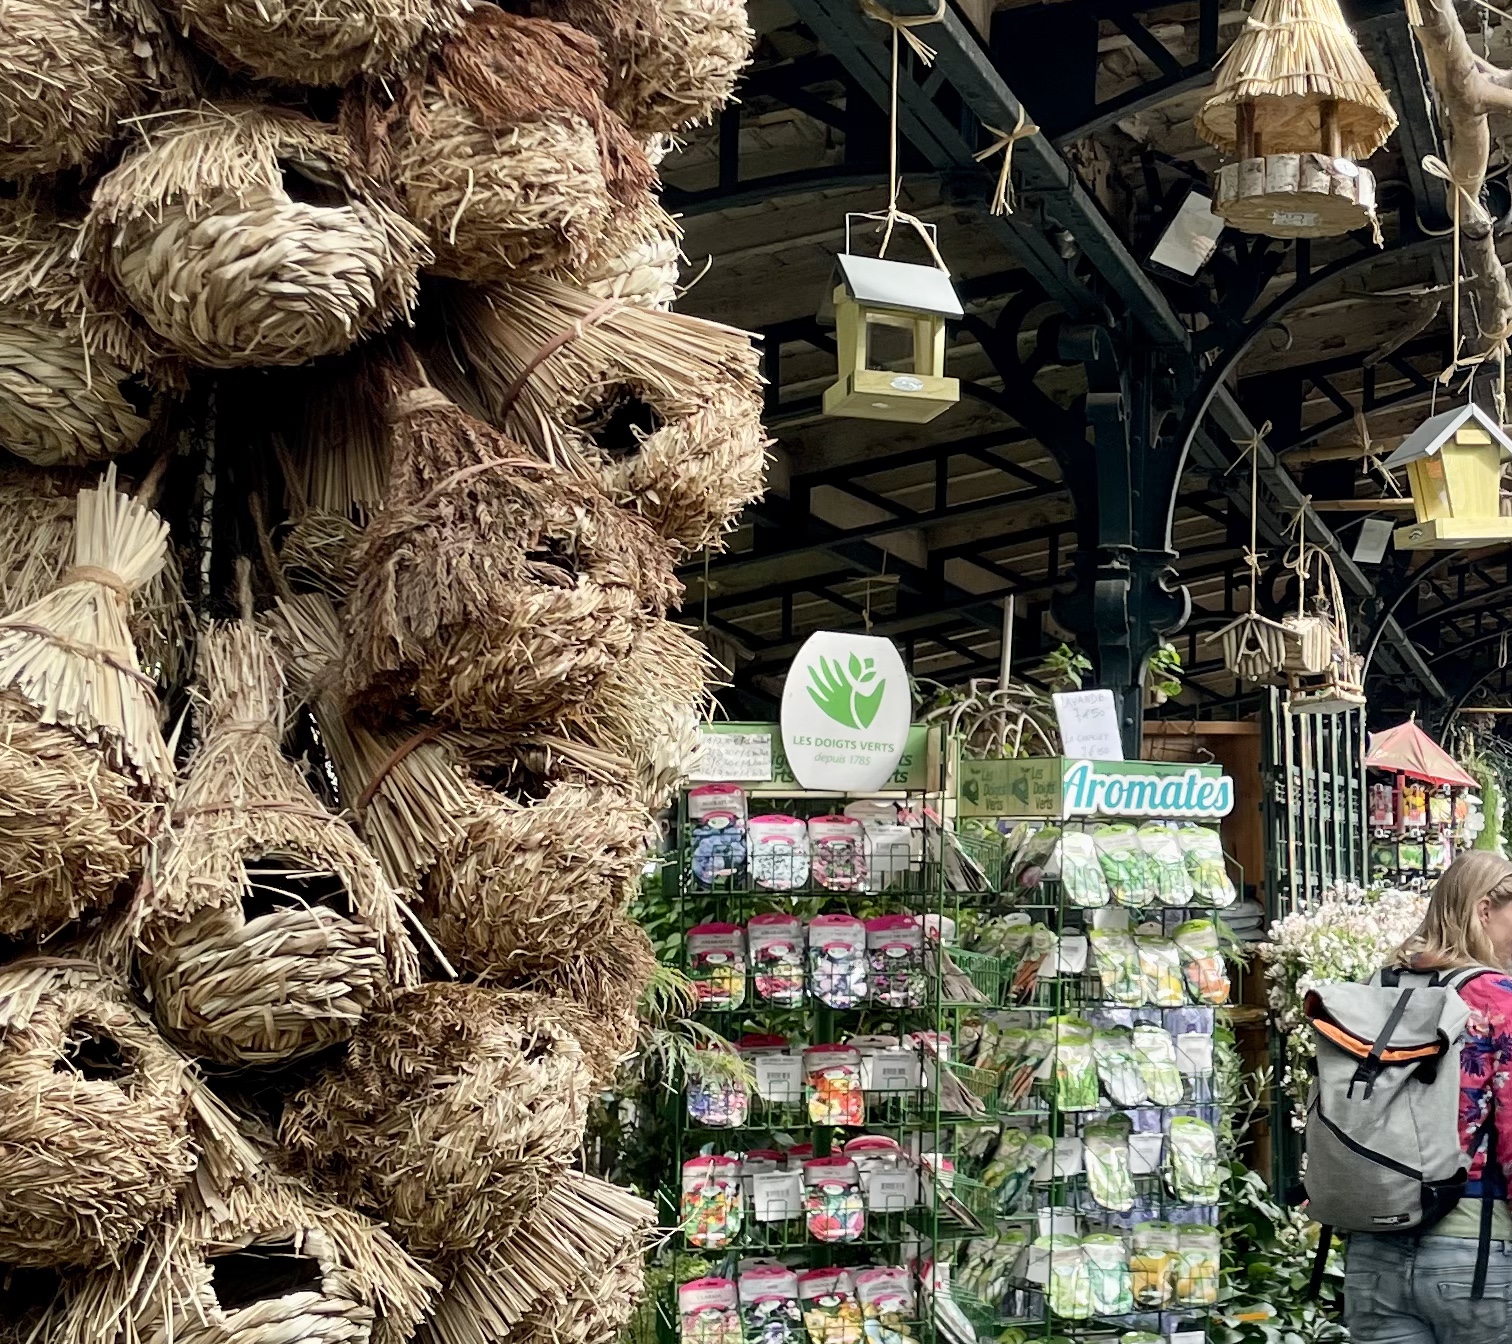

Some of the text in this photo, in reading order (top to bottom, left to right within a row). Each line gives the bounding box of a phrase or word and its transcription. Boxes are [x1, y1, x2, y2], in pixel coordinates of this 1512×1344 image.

[793, 735, 895, 753] LES DOIGTS VERTS
[814, 752, 872, 766] depuis 1785
[1064, 765, 1230, 812] Aromates
